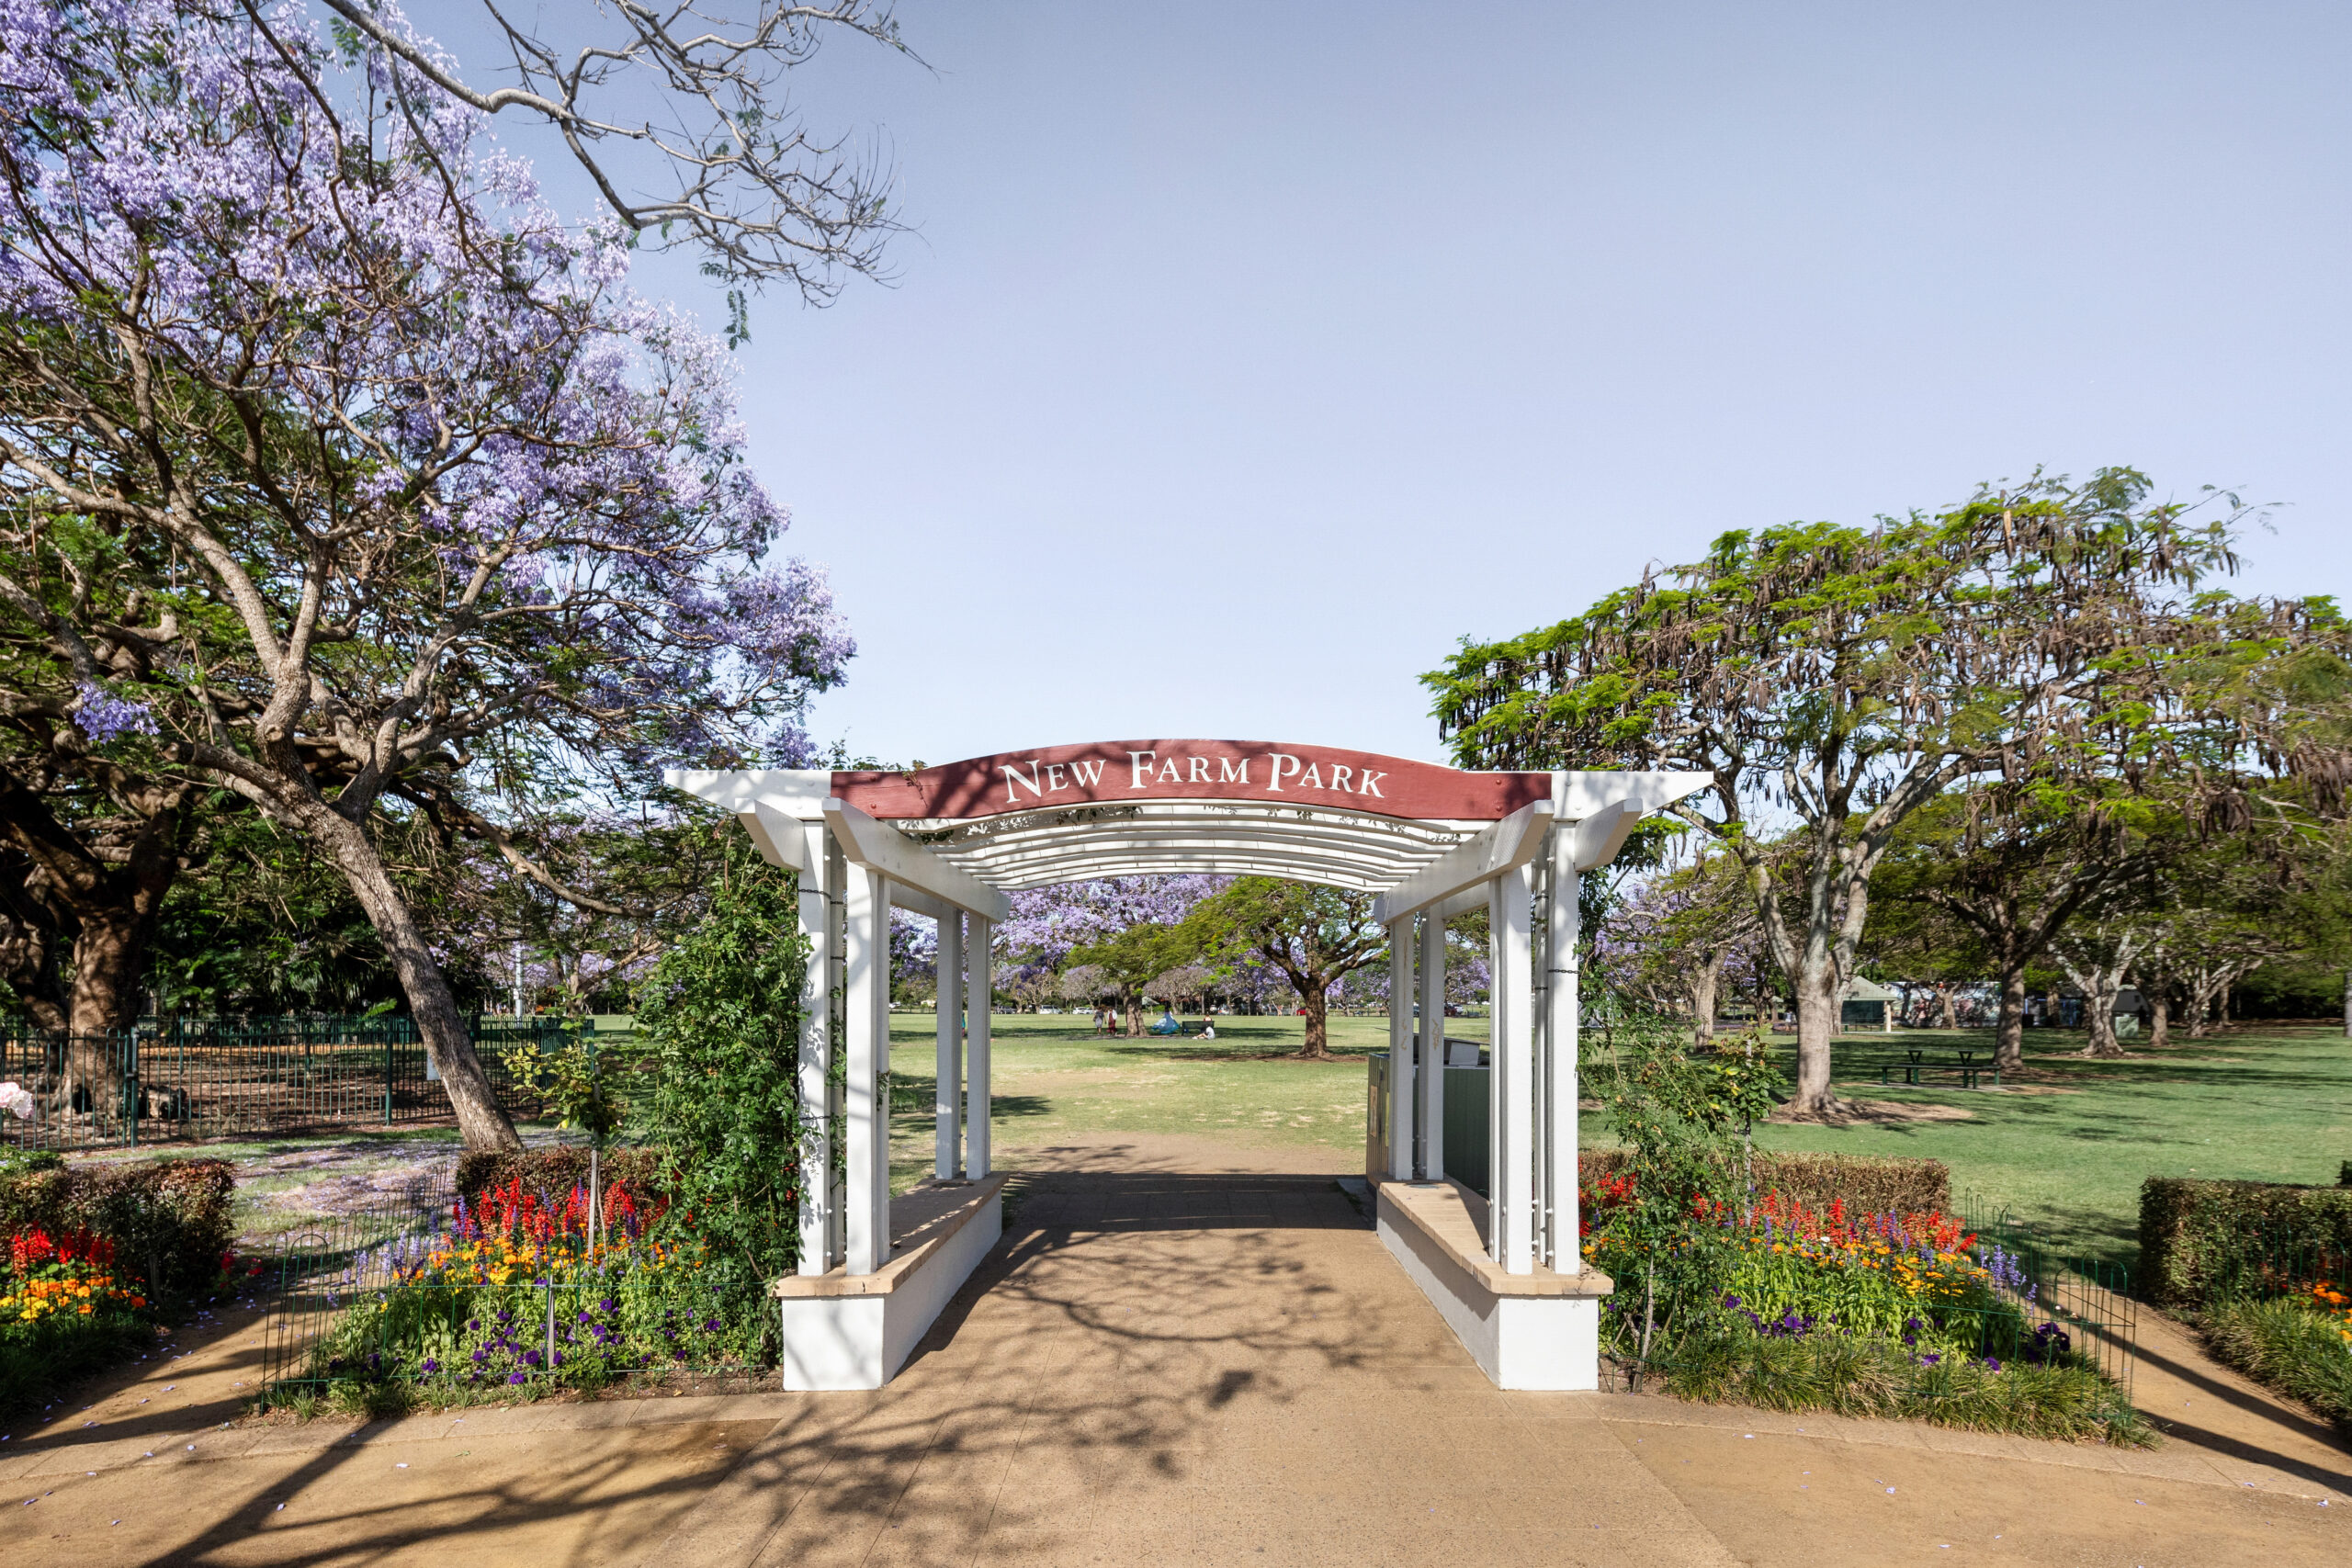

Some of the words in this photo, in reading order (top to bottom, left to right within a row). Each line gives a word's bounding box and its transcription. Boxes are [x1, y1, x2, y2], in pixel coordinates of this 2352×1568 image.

[998, 759, 1106, 803] NEW
[1125, 750, 1250, 789] FARM
[1266, 751, 1388, 798] PARK
